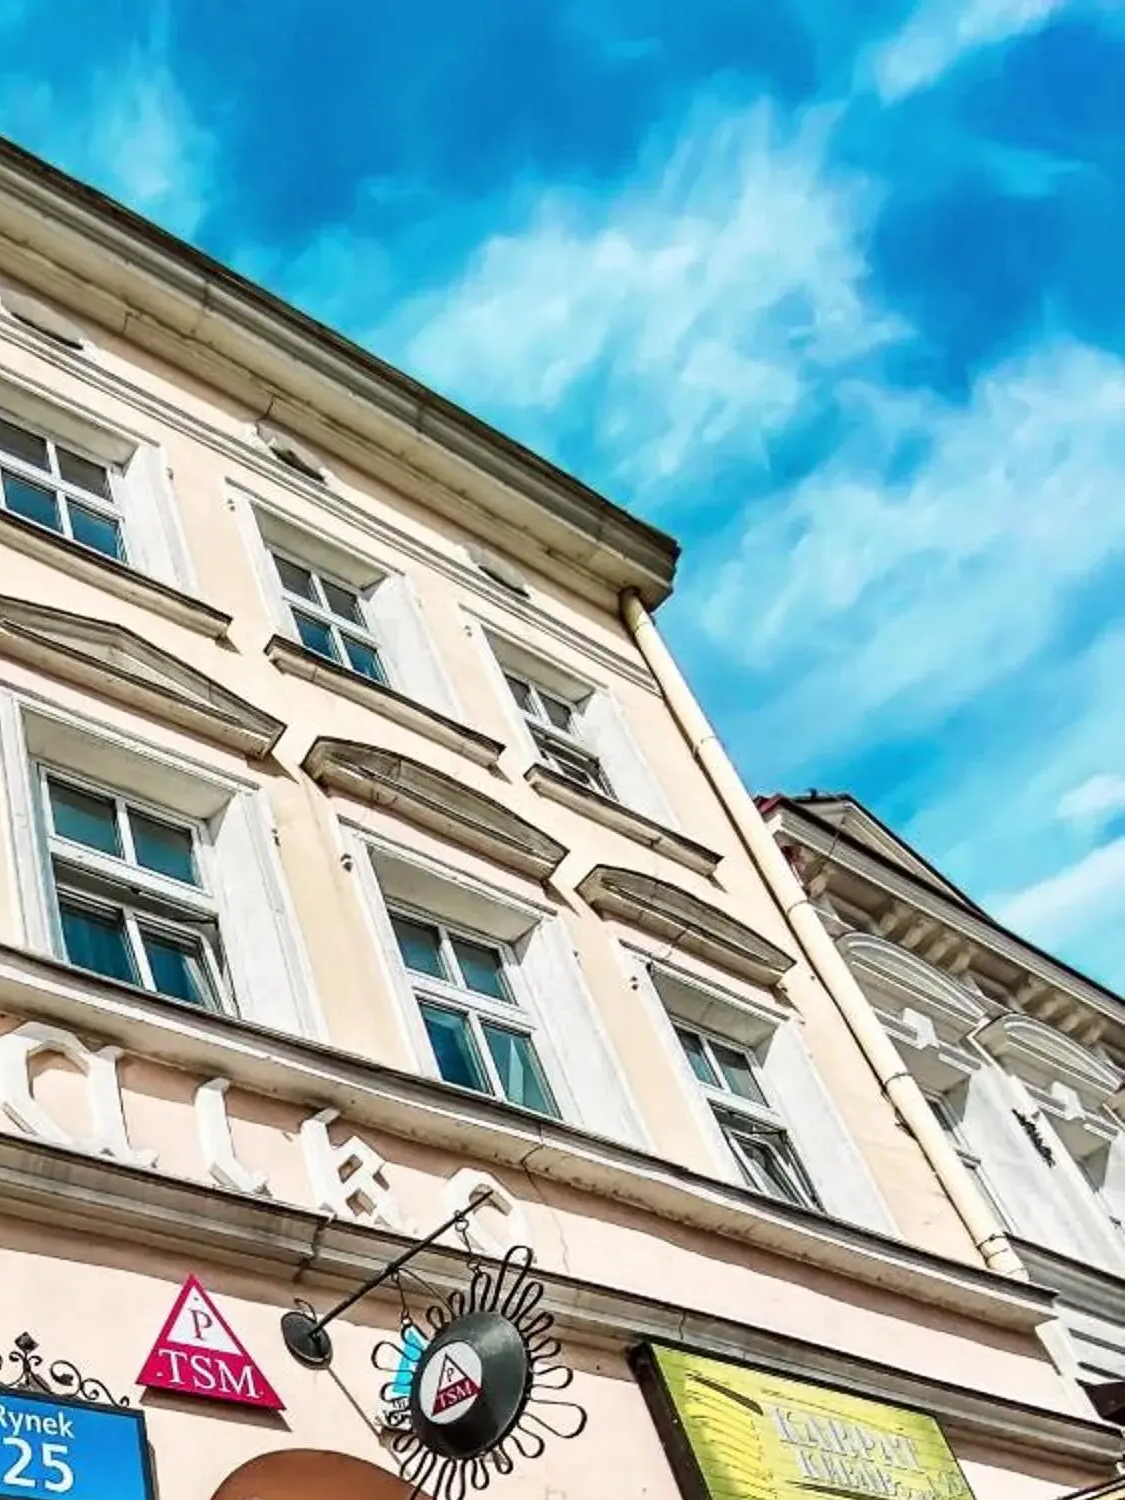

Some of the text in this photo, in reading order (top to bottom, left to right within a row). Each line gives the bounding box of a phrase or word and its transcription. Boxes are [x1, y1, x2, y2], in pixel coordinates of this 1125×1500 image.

[187, 1307, 213, 1341] P
[157, 1347, 260, 1400] TSM
[446, 1367, 455, 1383] P
[437, 1380, 473, 1409] TSM
[2, 1436, 74, 1493] 25
